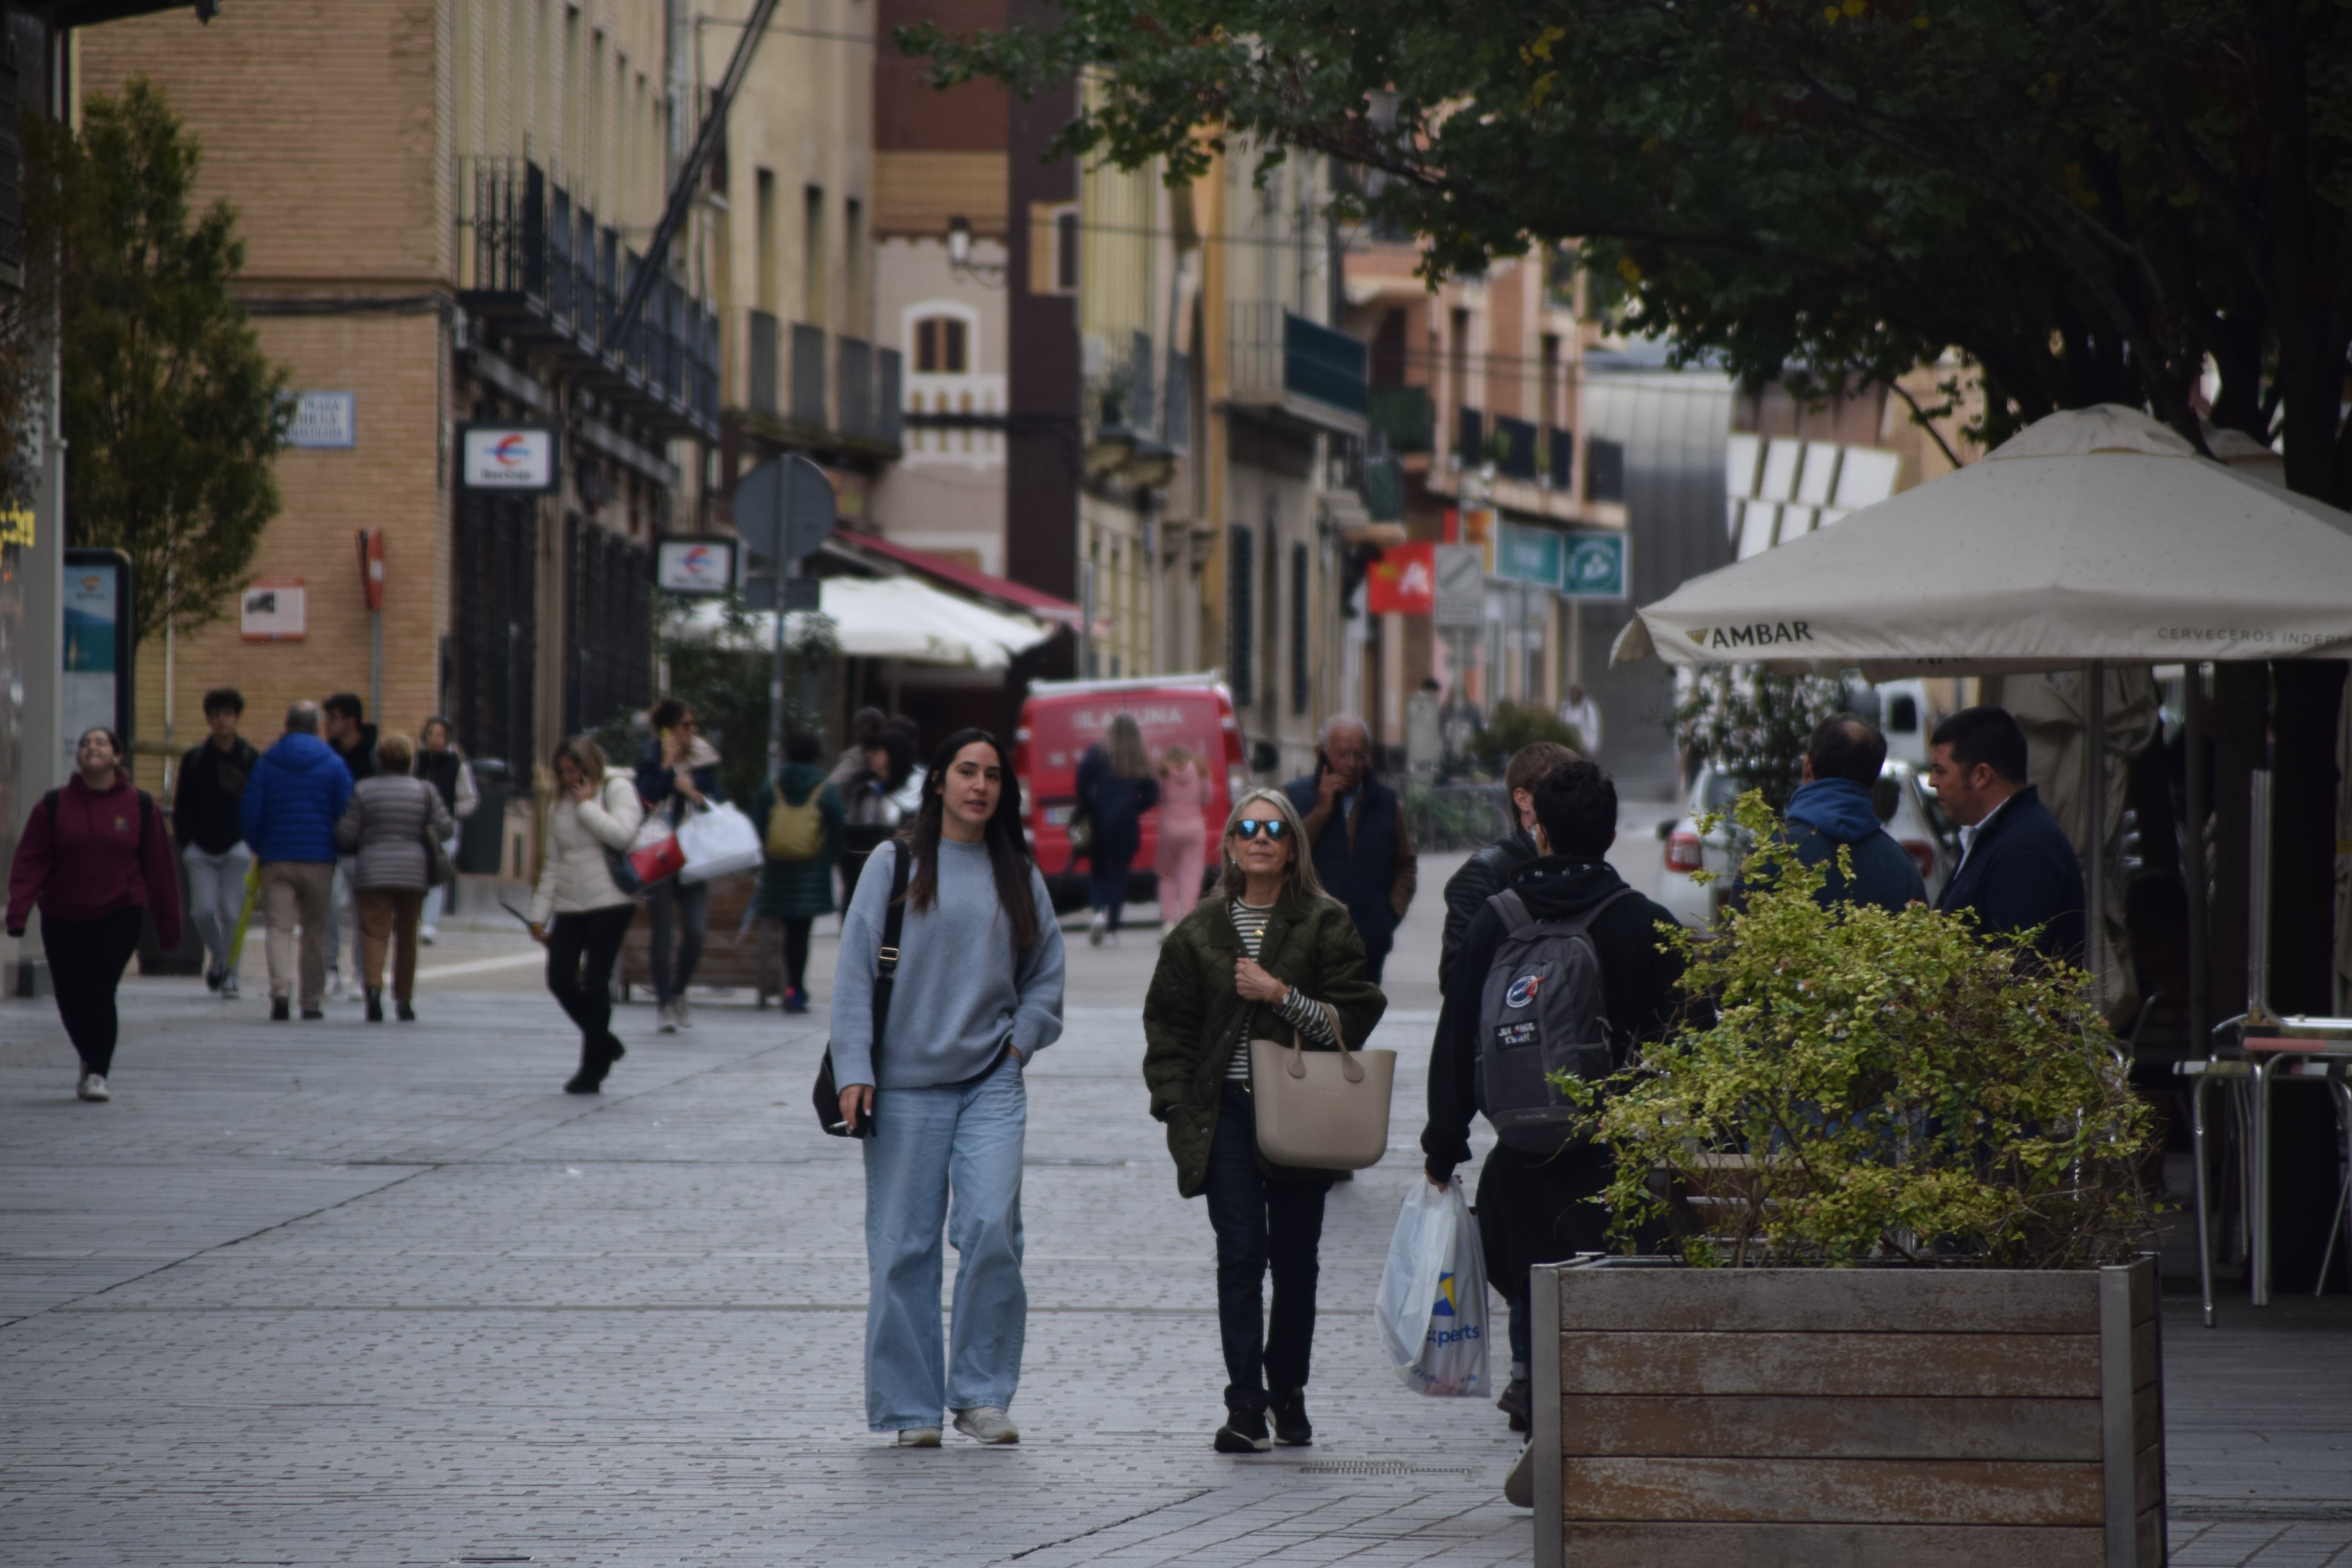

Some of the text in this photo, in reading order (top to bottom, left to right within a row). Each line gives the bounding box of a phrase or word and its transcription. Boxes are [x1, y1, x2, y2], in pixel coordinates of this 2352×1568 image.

[304, 399, 340, 410] PLAZA
[1712, 621, 1815, 649] AMBAR
[2158, 628, 2274, 642] CERVECEROS
